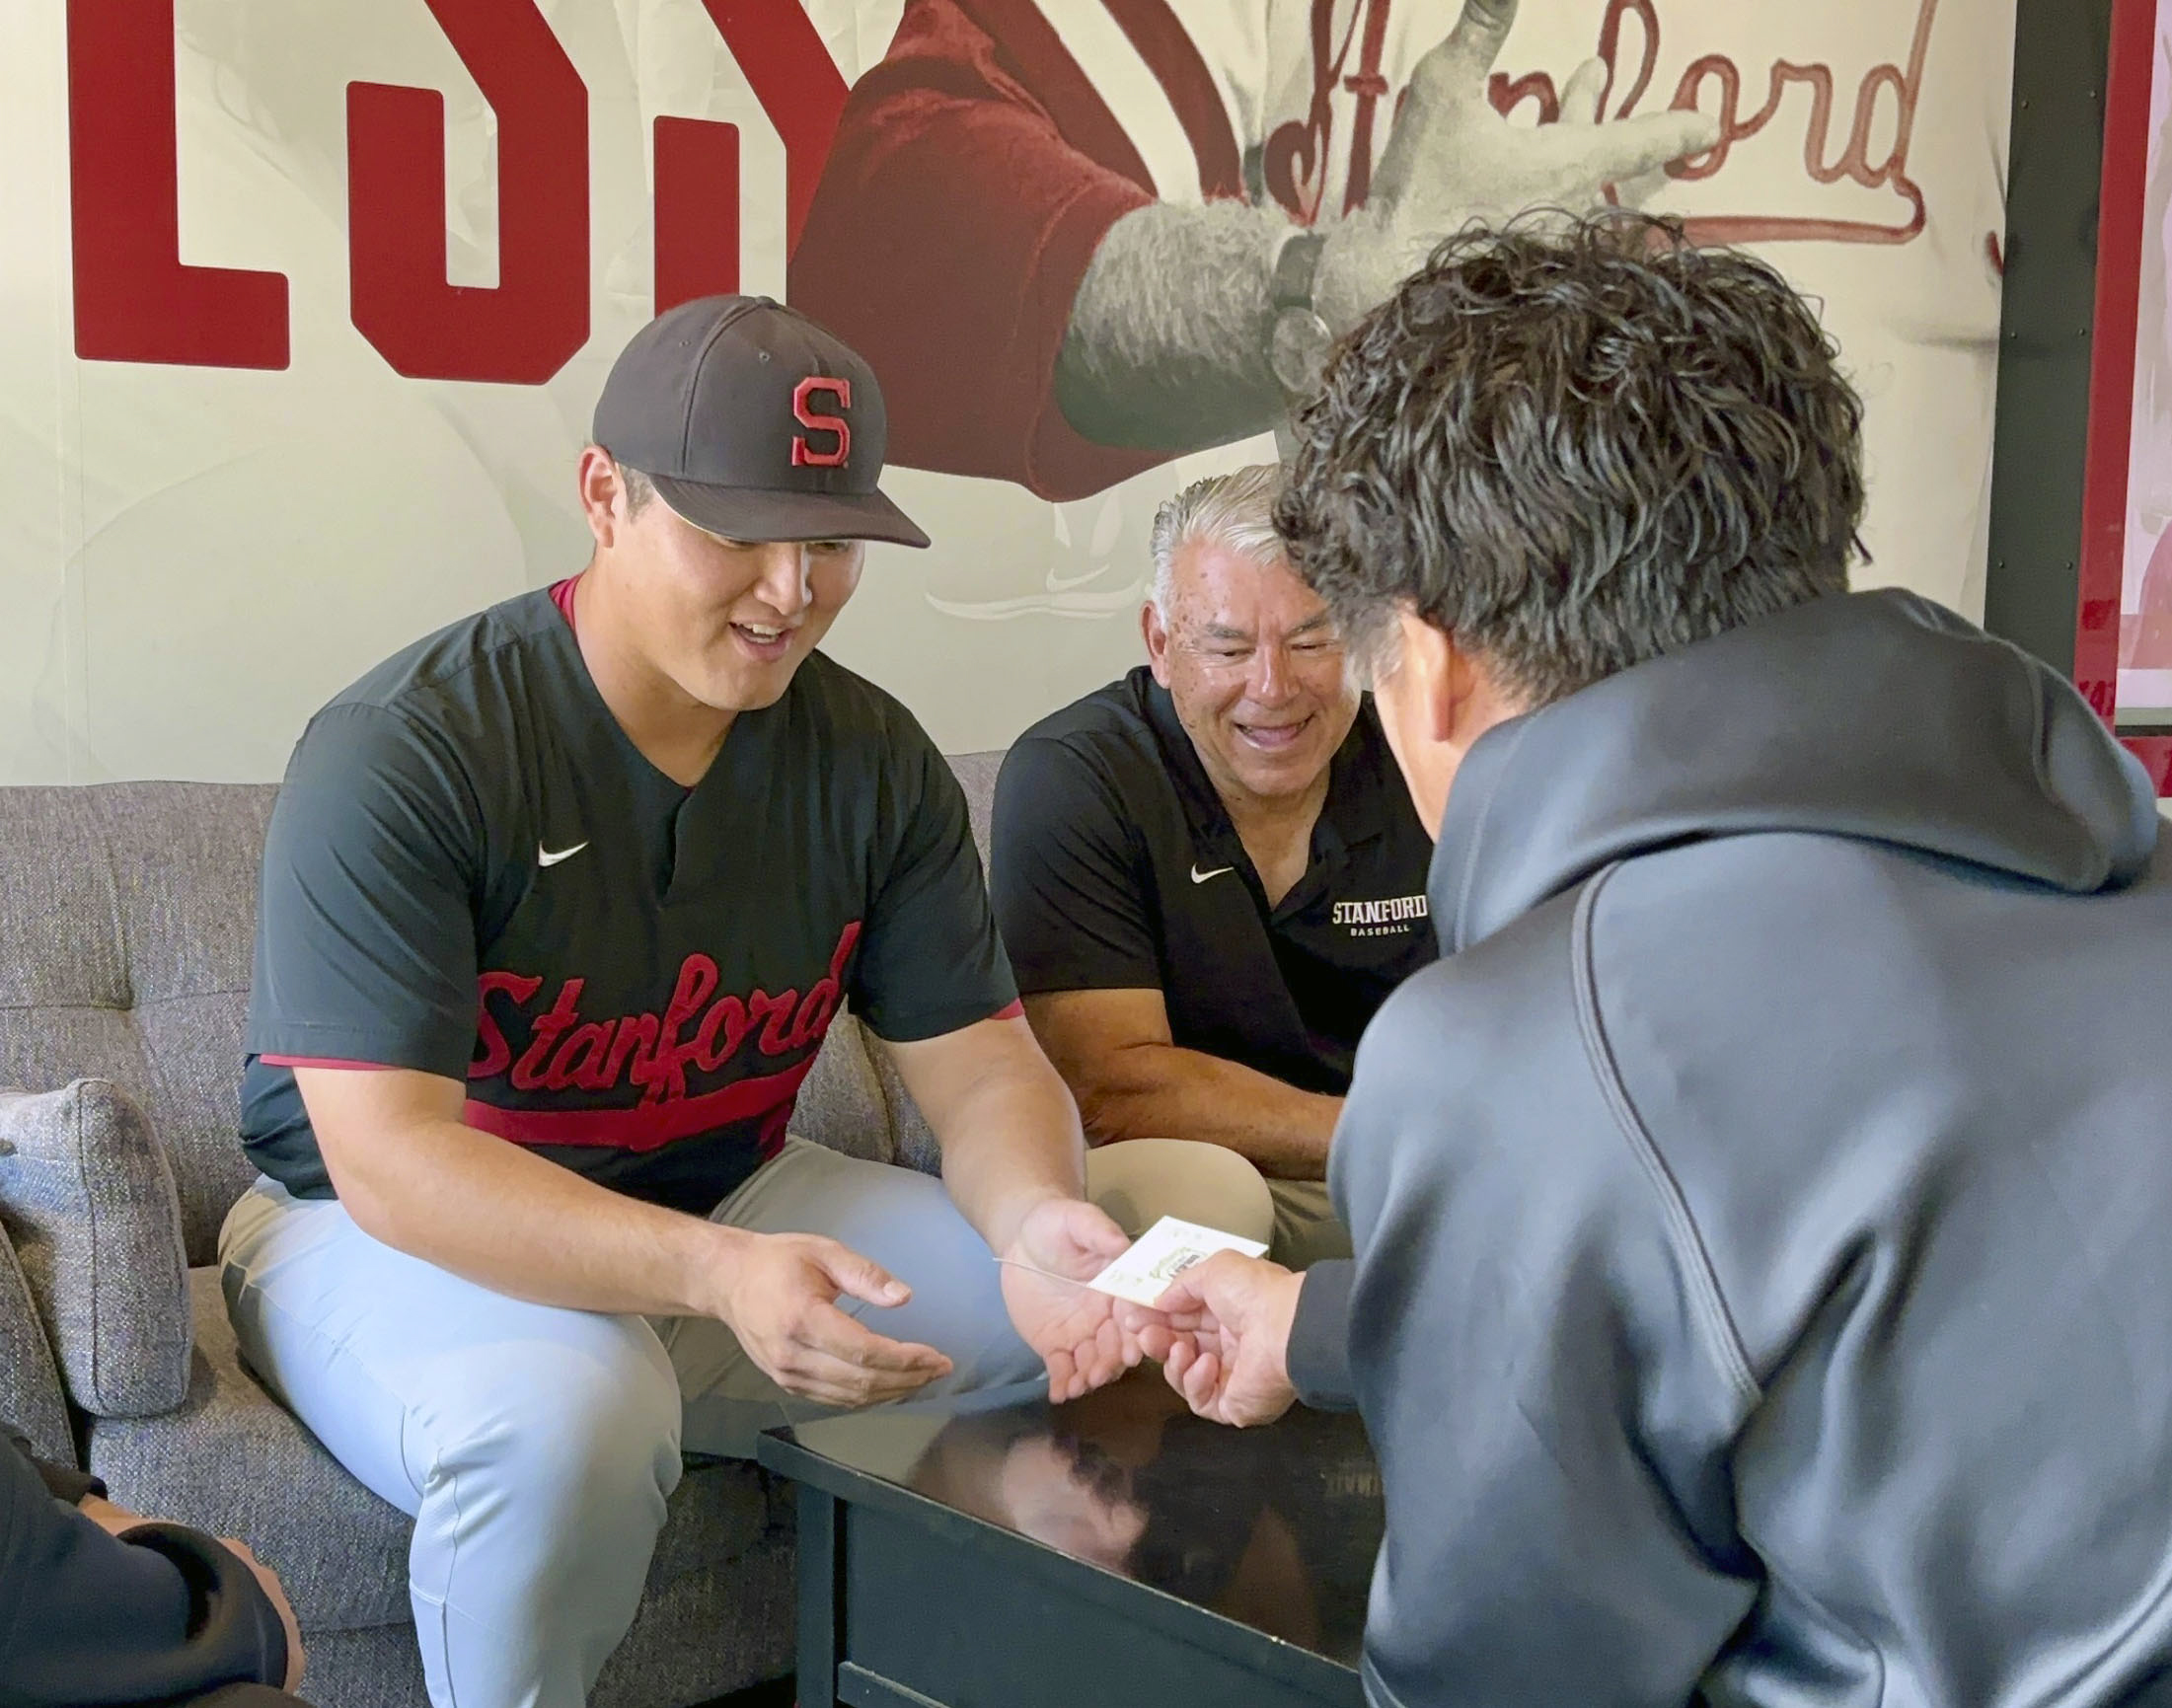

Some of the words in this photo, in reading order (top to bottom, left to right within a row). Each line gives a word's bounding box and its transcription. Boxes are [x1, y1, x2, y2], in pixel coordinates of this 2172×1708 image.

[792, 376, 851, 467] S
[1332, 895, 1428, 925] STANFORD
[1350, 925, 1410, 936] BASEBALL
[468, 921, 861, 1106] Stanford
